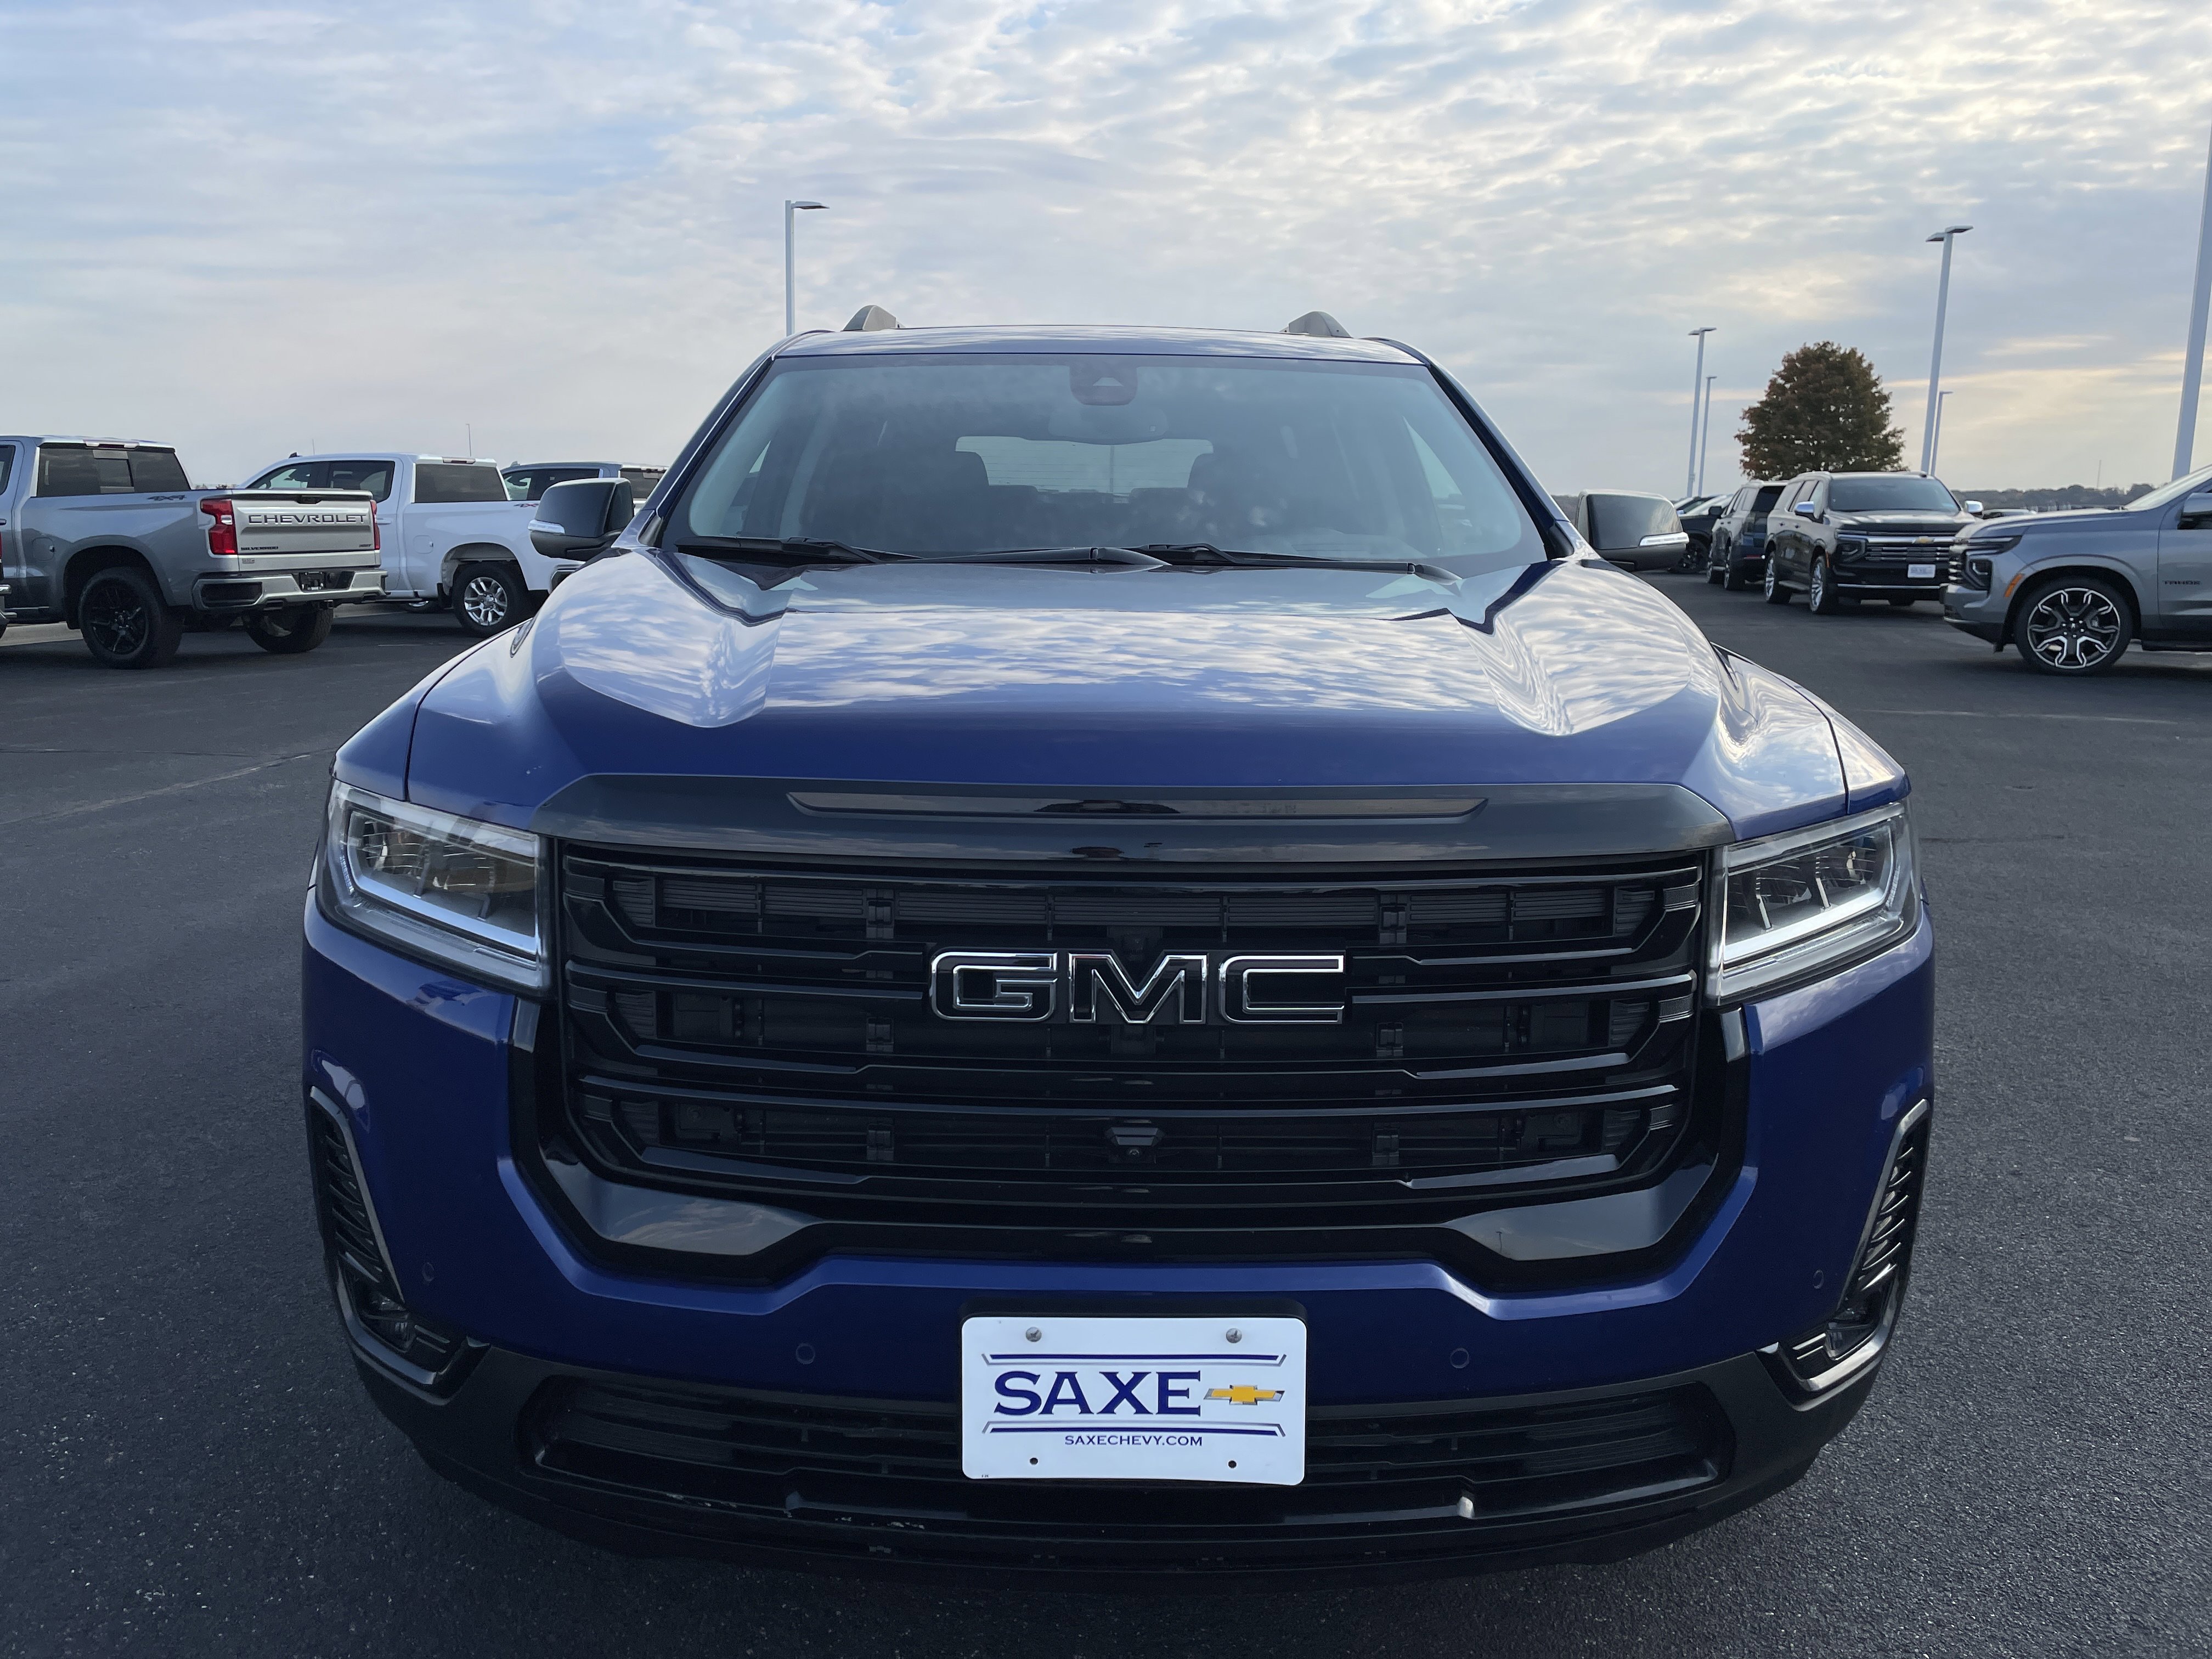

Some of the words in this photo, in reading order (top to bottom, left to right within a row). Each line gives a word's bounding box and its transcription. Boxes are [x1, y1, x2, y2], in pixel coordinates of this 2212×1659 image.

[249, 515, 366, 524] CHEVROLET
[929, 948, 1345, 1025] GMC
[994, 1370, 1201, 1417] SAXE
[1065, 1435, 1202, 1446] SAXECHEVY.COM
